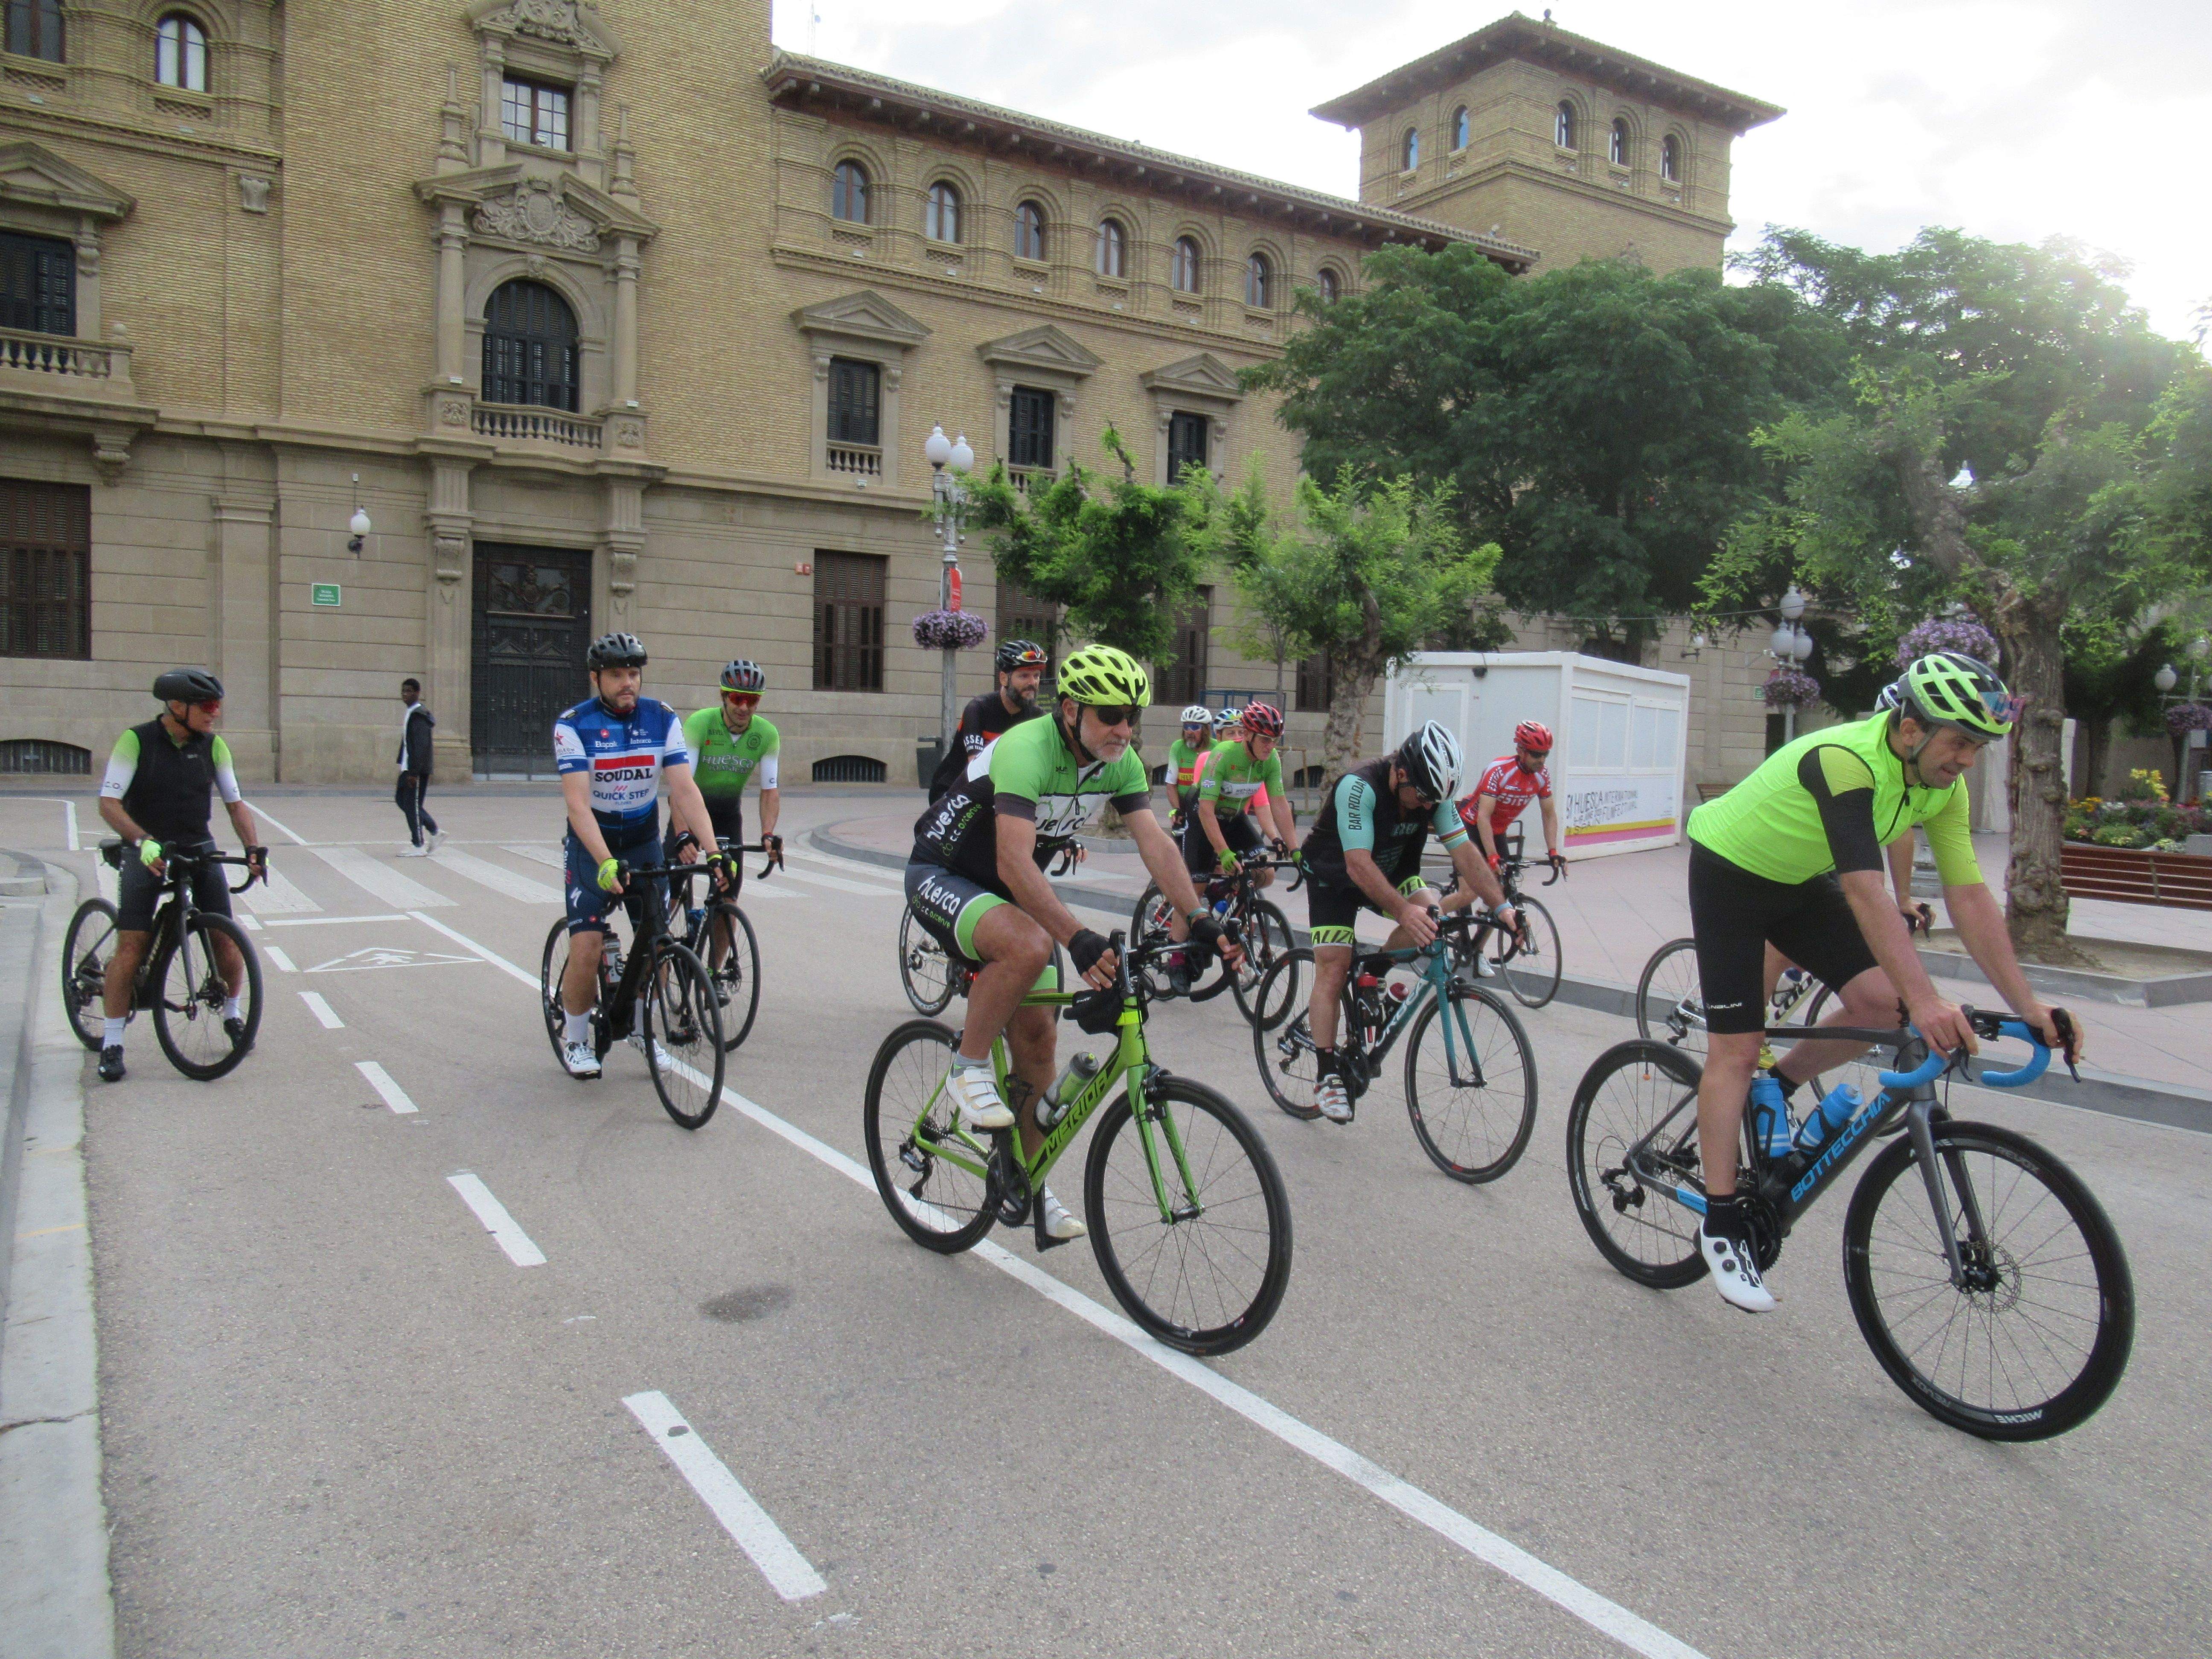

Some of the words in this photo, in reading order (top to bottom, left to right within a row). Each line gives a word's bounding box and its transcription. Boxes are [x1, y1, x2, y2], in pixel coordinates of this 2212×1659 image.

[595, 768, 653, 783] SOUDAL
[593, 790, 626, 800] QUICK
[629, 789, 649, 799] STEP
[1348, 811, 1362, 830] BAR
[1791, 1091, 1892, 1202] BOTTECCHIA
[1992, 1409, 2043, 1424] MICHE
